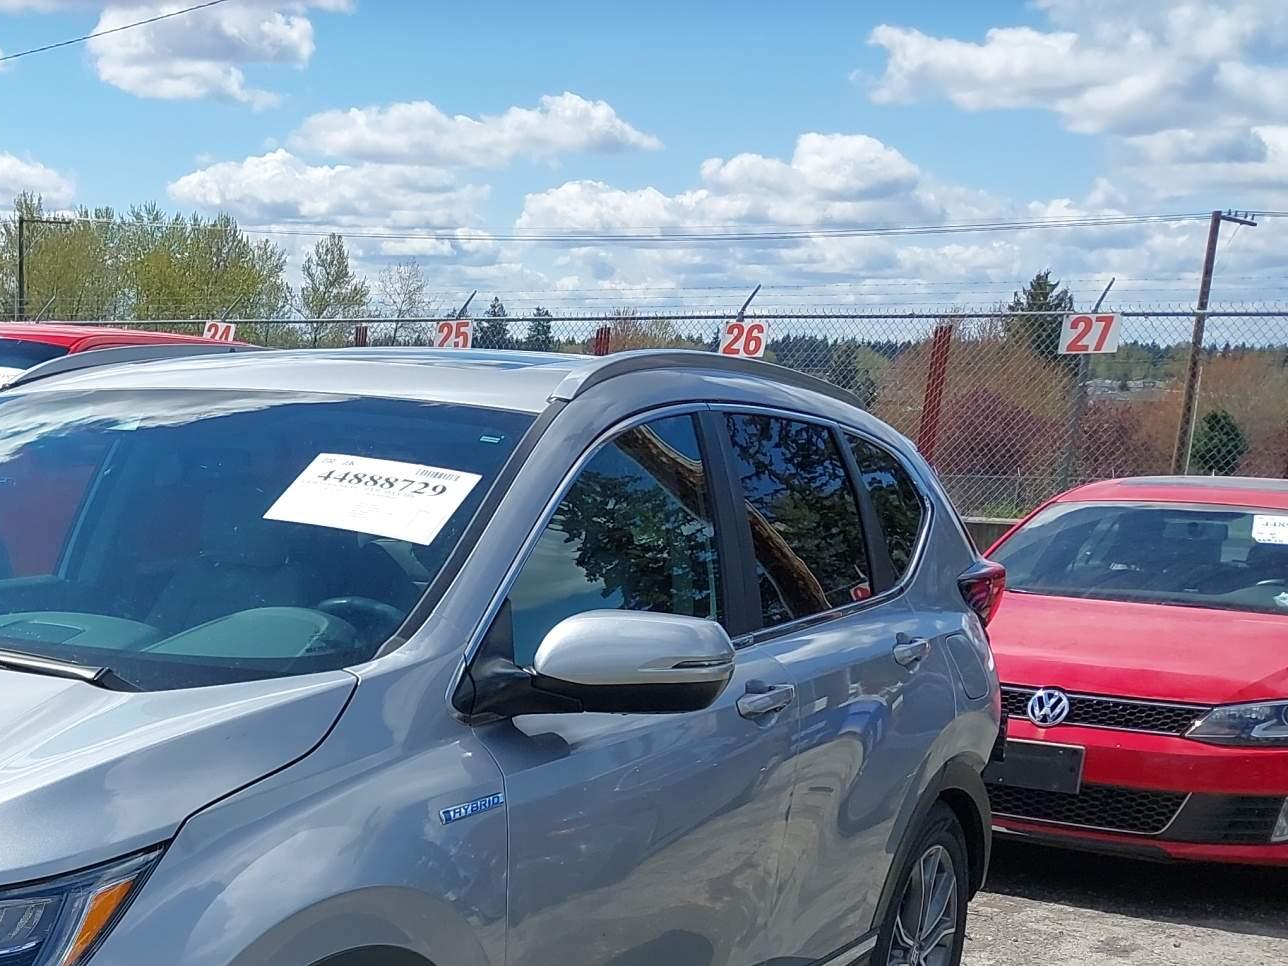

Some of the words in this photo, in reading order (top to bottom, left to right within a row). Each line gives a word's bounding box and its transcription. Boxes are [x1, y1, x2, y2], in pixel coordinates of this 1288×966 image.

[208, 322, 232, 341] 24
[438, 321, 470, 348] 25
[722, 323, 765, 356] 26
[1065, 315, 1115, 352] 27
[317, 469, 447, 497] 44888729
[452, 795, 500, 819] HYBRID
